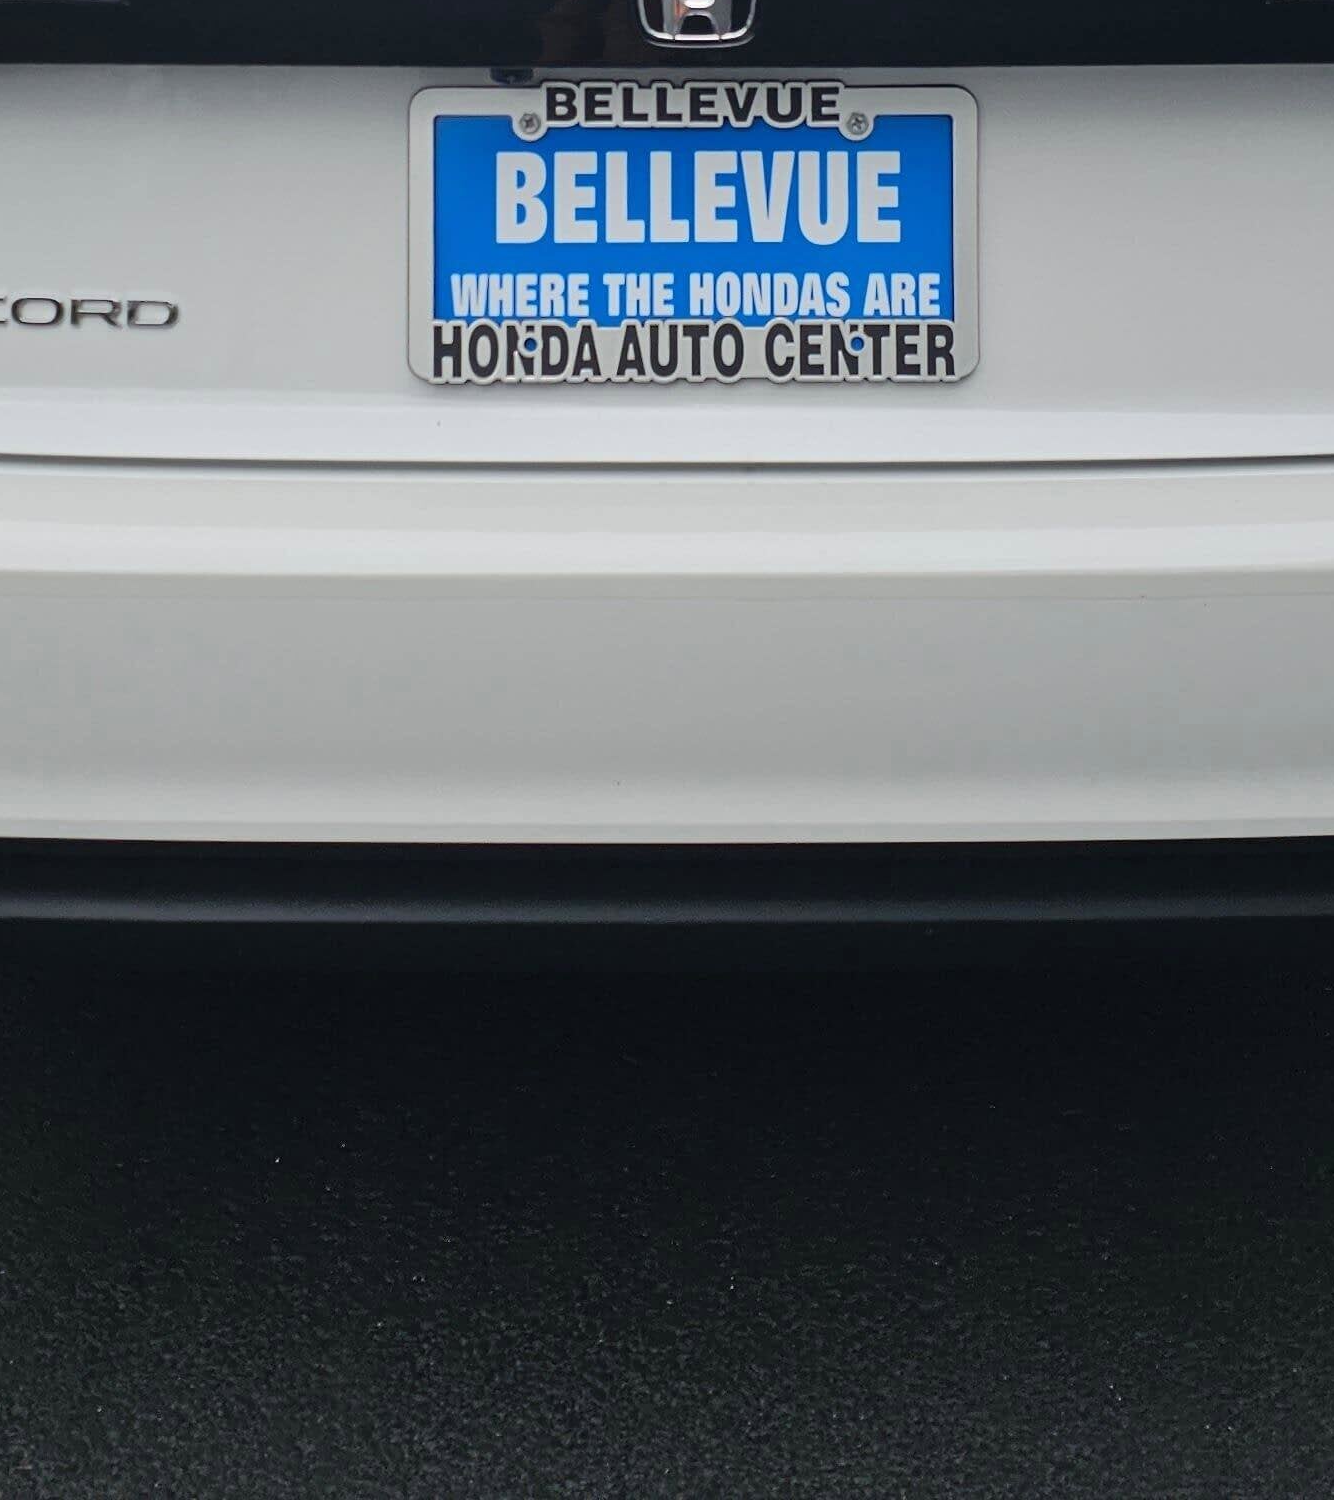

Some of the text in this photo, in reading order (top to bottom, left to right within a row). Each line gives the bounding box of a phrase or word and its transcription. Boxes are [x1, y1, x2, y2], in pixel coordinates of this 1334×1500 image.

[546, 86, 840, 122] BELLEVUE
[495, 150, 902, 245] BELLEVUE
[450, 271, 941, 318] WHERE THE HONDAS ARE
[432, 323, 957, 378] HONDA AUTO CENTER
